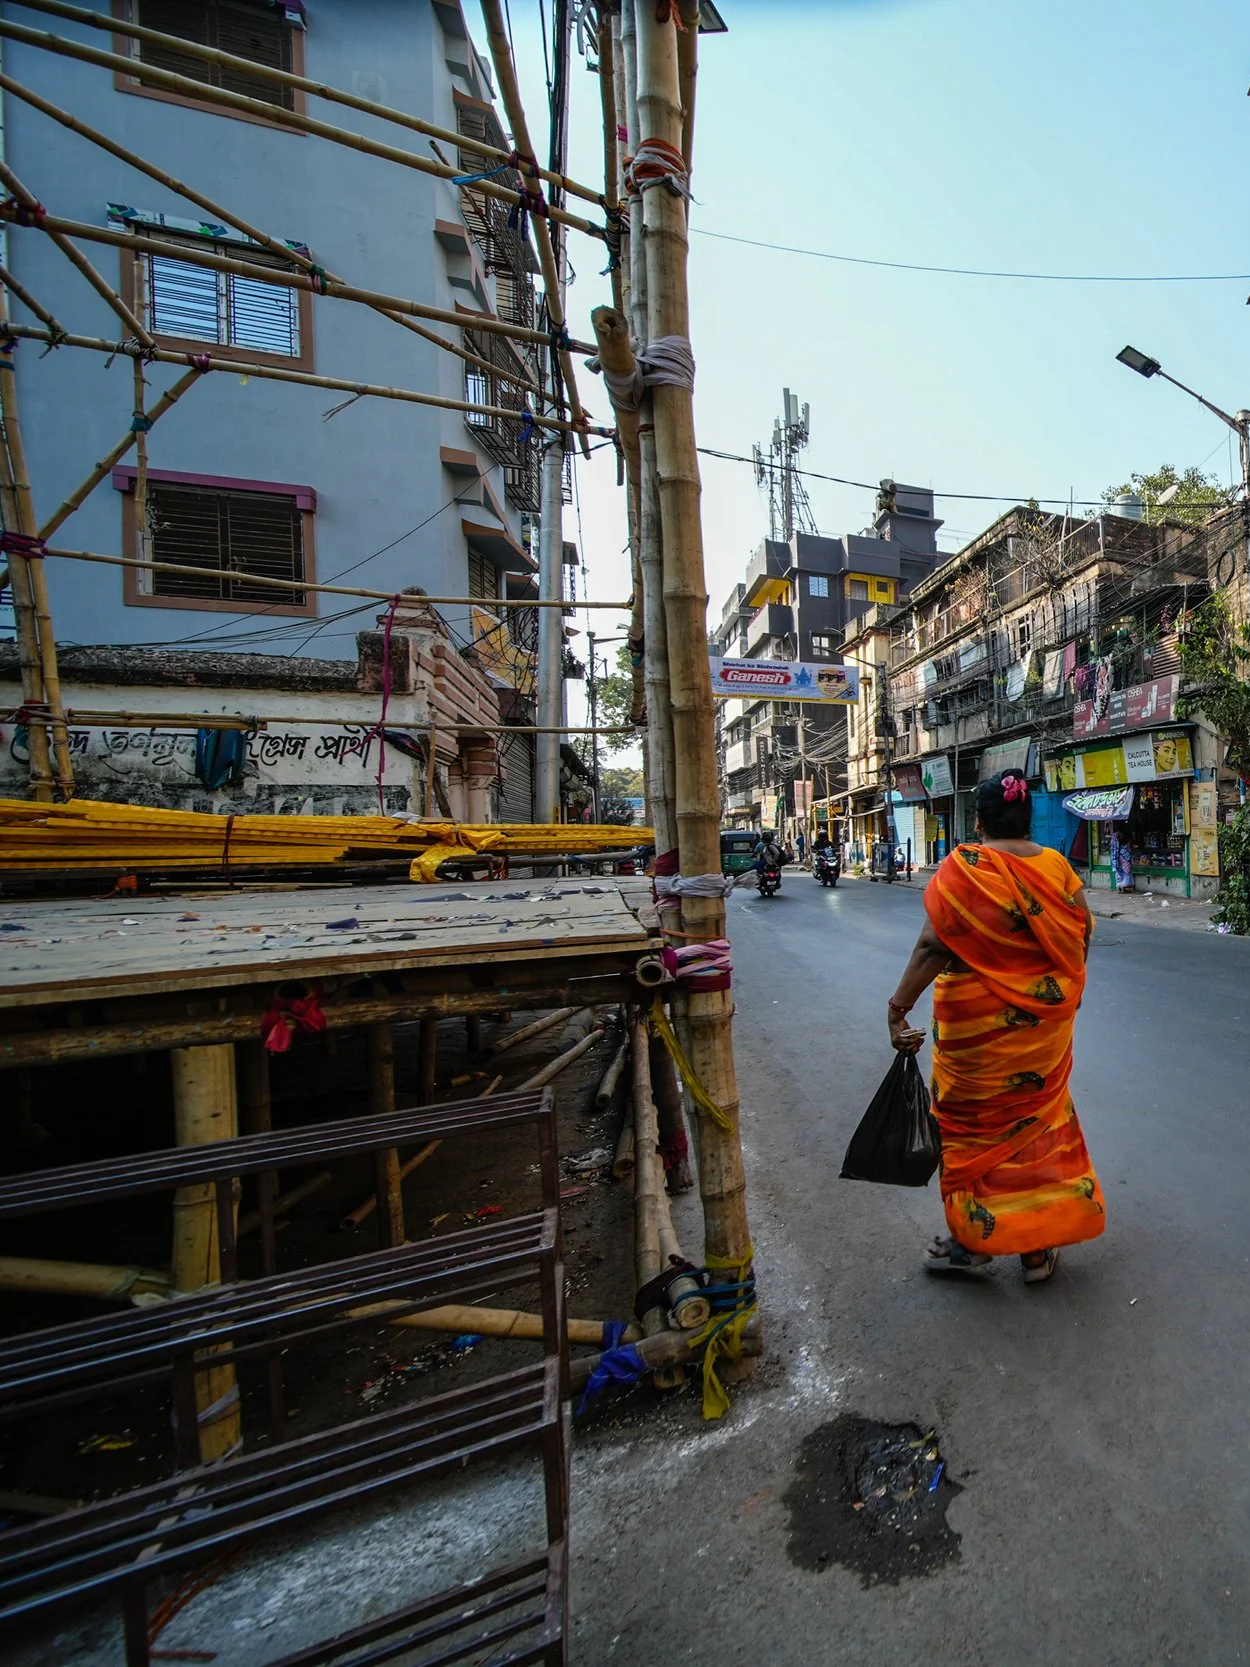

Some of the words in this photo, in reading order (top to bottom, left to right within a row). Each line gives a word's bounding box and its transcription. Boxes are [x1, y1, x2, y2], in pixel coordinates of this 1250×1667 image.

[727, 670, 785, 684] Ganesh
[1127, 750, 1150, 759] CALCUTTA
[1138, 759, 1153, 767] HOUSE
